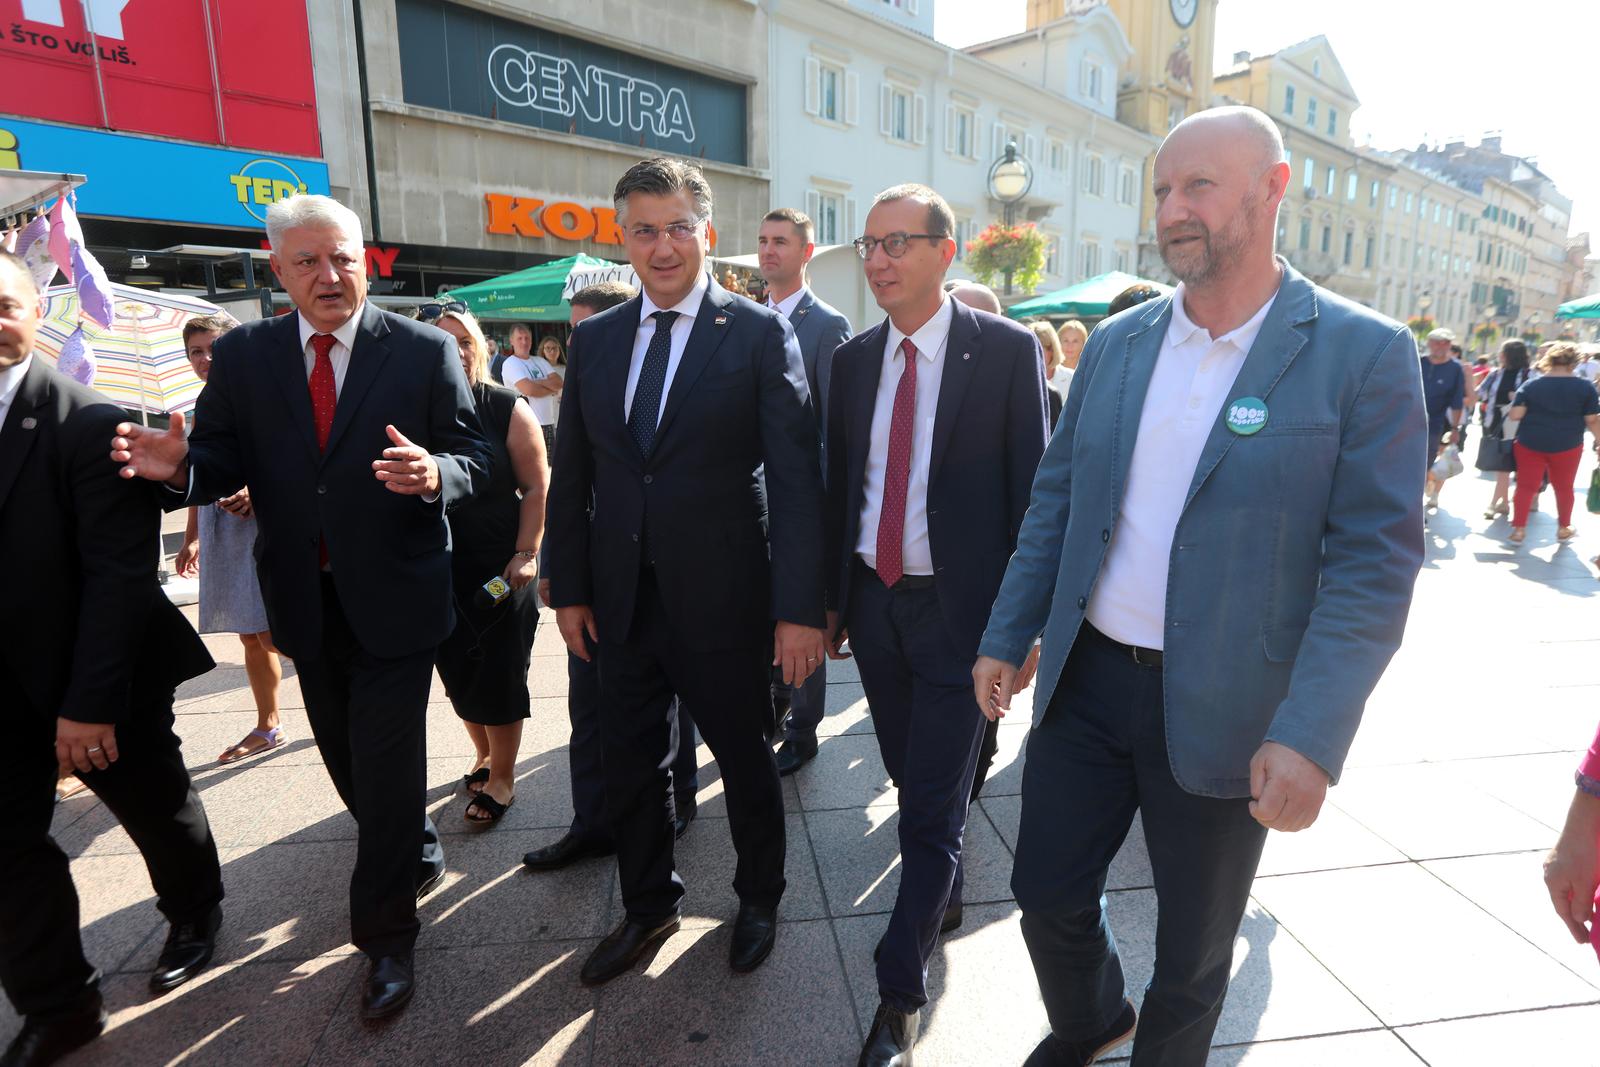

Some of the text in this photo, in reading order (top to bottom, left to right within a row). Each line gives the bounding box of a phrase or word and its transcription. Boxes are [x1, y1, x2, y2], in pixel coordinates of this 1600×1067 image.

[10, 23, 59, 49] ŠTO
[65, 39, 137, 66] VOLIŠ.
[488, 44, 695, 143] CENTRA
[1230, 405, 1265, 419] 100%
